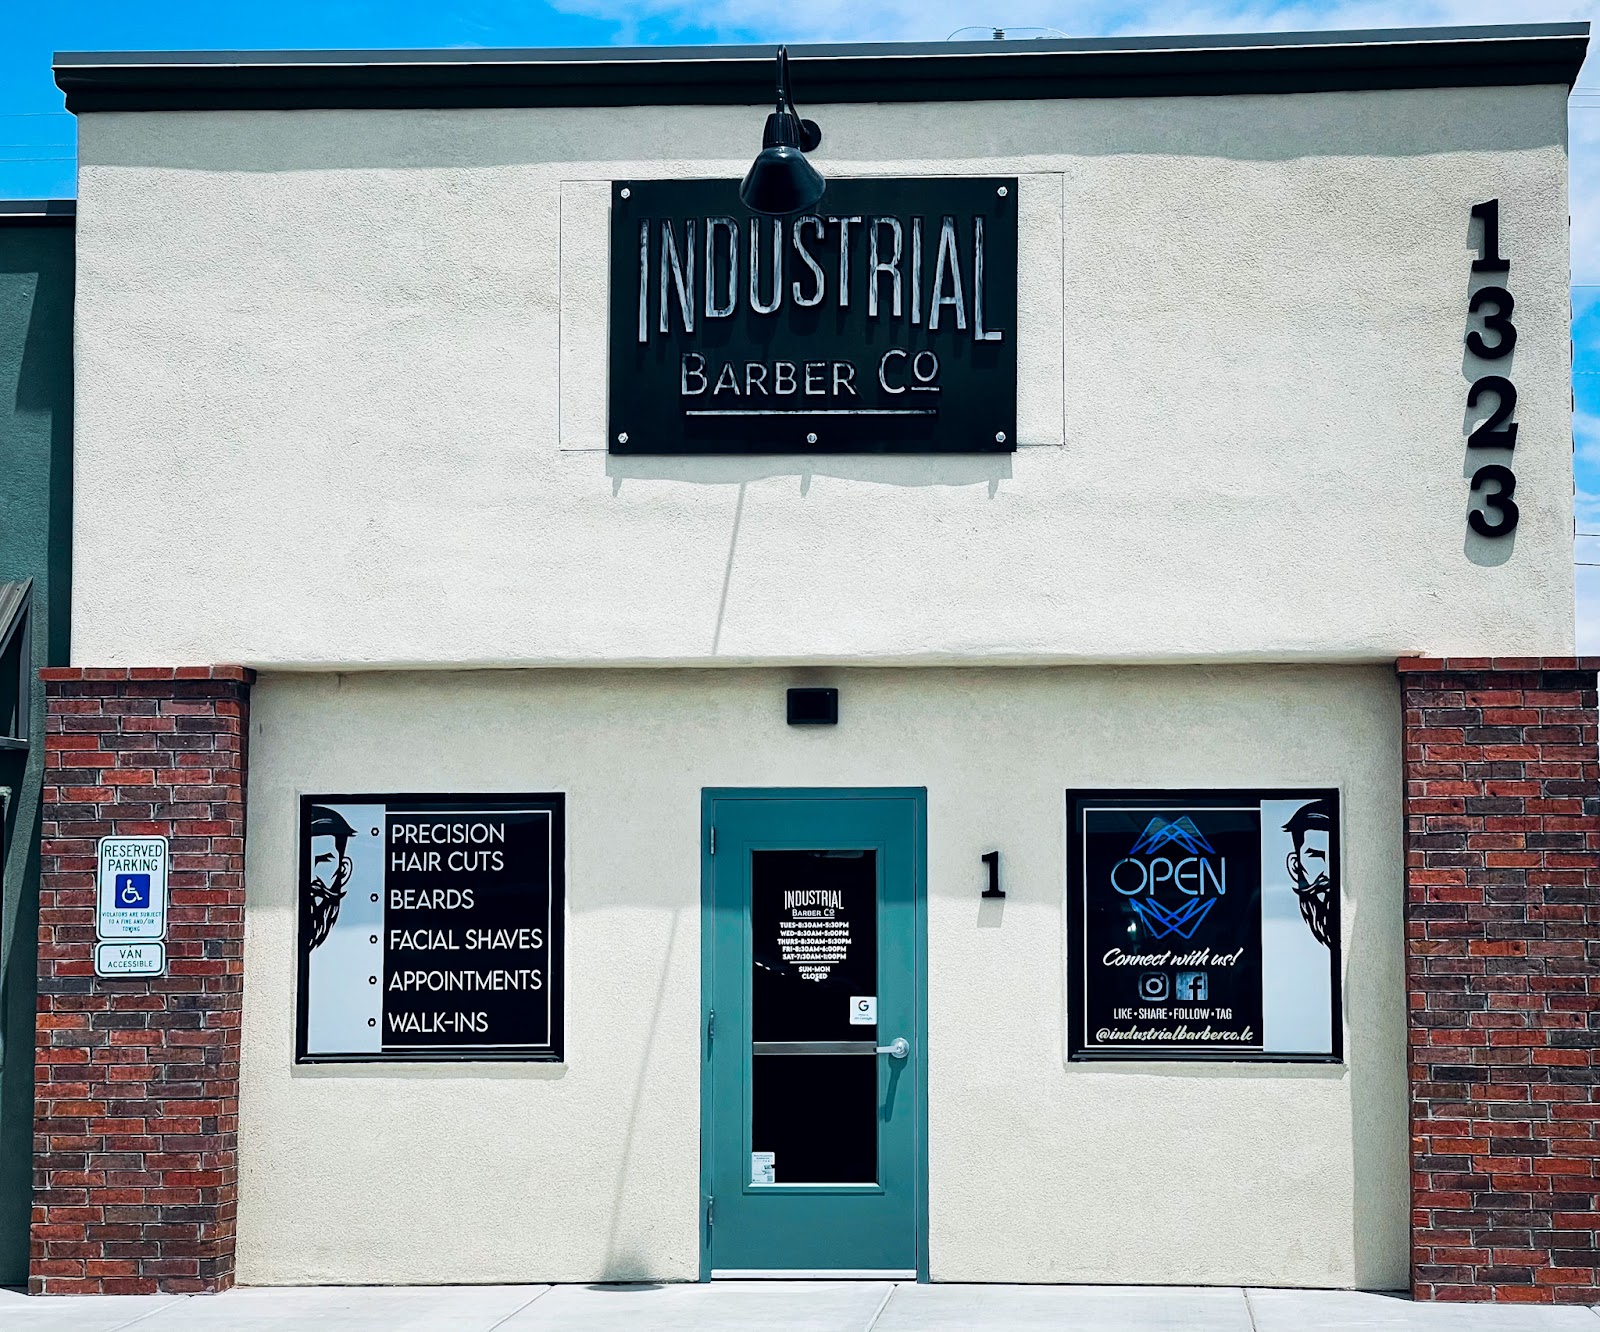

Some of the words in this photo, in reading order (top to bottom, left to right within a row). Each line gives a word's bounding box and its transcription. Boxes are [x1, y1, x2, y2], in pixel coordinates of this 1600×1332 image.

[638, 215, 1002, 343] INDUSTRIAL
[681, 352, 857, 396] BARBER
[391, 823, 505, 844] PRECISION
[104, 844, 163, 857] RESERVED
[108, 859, 158, 872] PARKING
[391, 852, 442, 872] HAIR
[447, 851, 504, 872] CUTS
[982, 850, 1006, 898] 1
[1110, 857, 1226, 896] OPEN
[390, 888, 475, 909] BEARDS
[784, 890, 844, 910] INDUSTRIAL
[133, 917, 155, 925] AND/OR
[390, 930, 460, 950] FACIAL
[465, 928, 543, 949] SHAVES
[119, 949, 142, 959] VAN
[1103, 947, 1171, 966] Connect
[1170, 947, 1210, 966] with
[1211, 947, 1244, 966] us!
[798, 965, 831, 973] SUN-MON
[801, 972, 828, 980] CLOSED
[388, 970, 543, 991] APPOINTMENTS
[858, 1000, 869, 1011] G
[388, 1012, 489, 1033] WALK-INS
